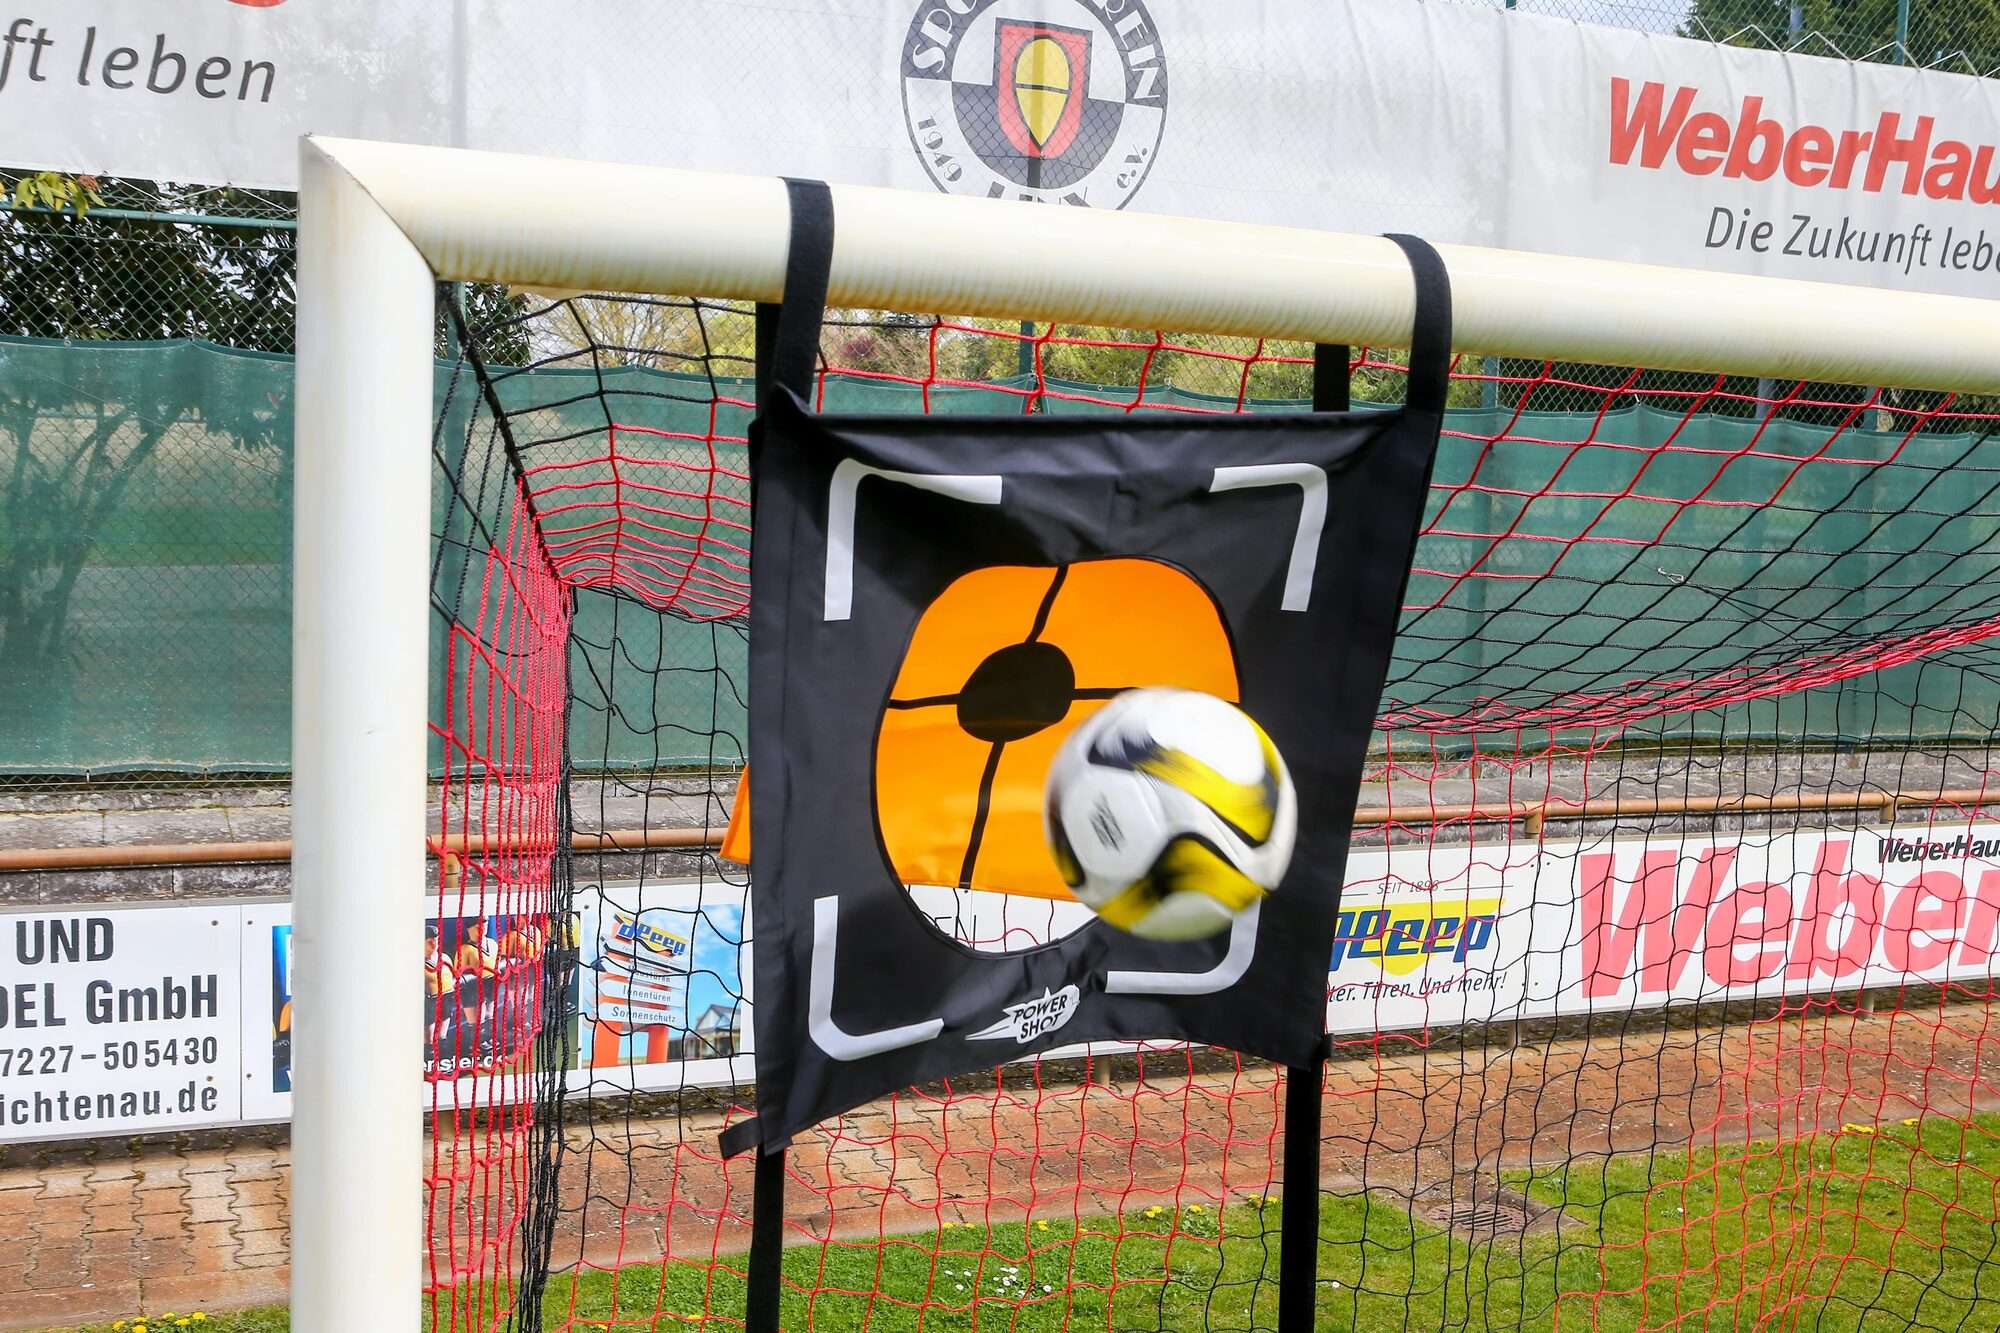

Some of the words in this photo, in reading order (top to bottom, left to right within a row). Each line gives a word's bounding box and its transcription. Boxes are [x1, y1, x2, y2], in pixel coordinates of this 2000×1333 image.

[77, 26, 276, 104] leben
[1608, 76, 2000, 205] WeberHau
[1704, 206, 1774, 253] Die
[1782, 213, 1933, 276] Zukunft
[1376, 881, 1403, 895] SEIT
[15, 917, 115, 965] UND
[1580, 839, 2000, 999] Weber
[86, 974, 218, 1025] GmbH
[623, 985, 672, 1002] Inentüren
[1013, 994, 1068, 1024] POWER
[1363, 980, 1414, 1000] Türen.
[1418, 975, 1455, 995] Und
[1458, 971, 1507, 992] mehr!
[1020, 1011, 1064, 1040] SHOT
